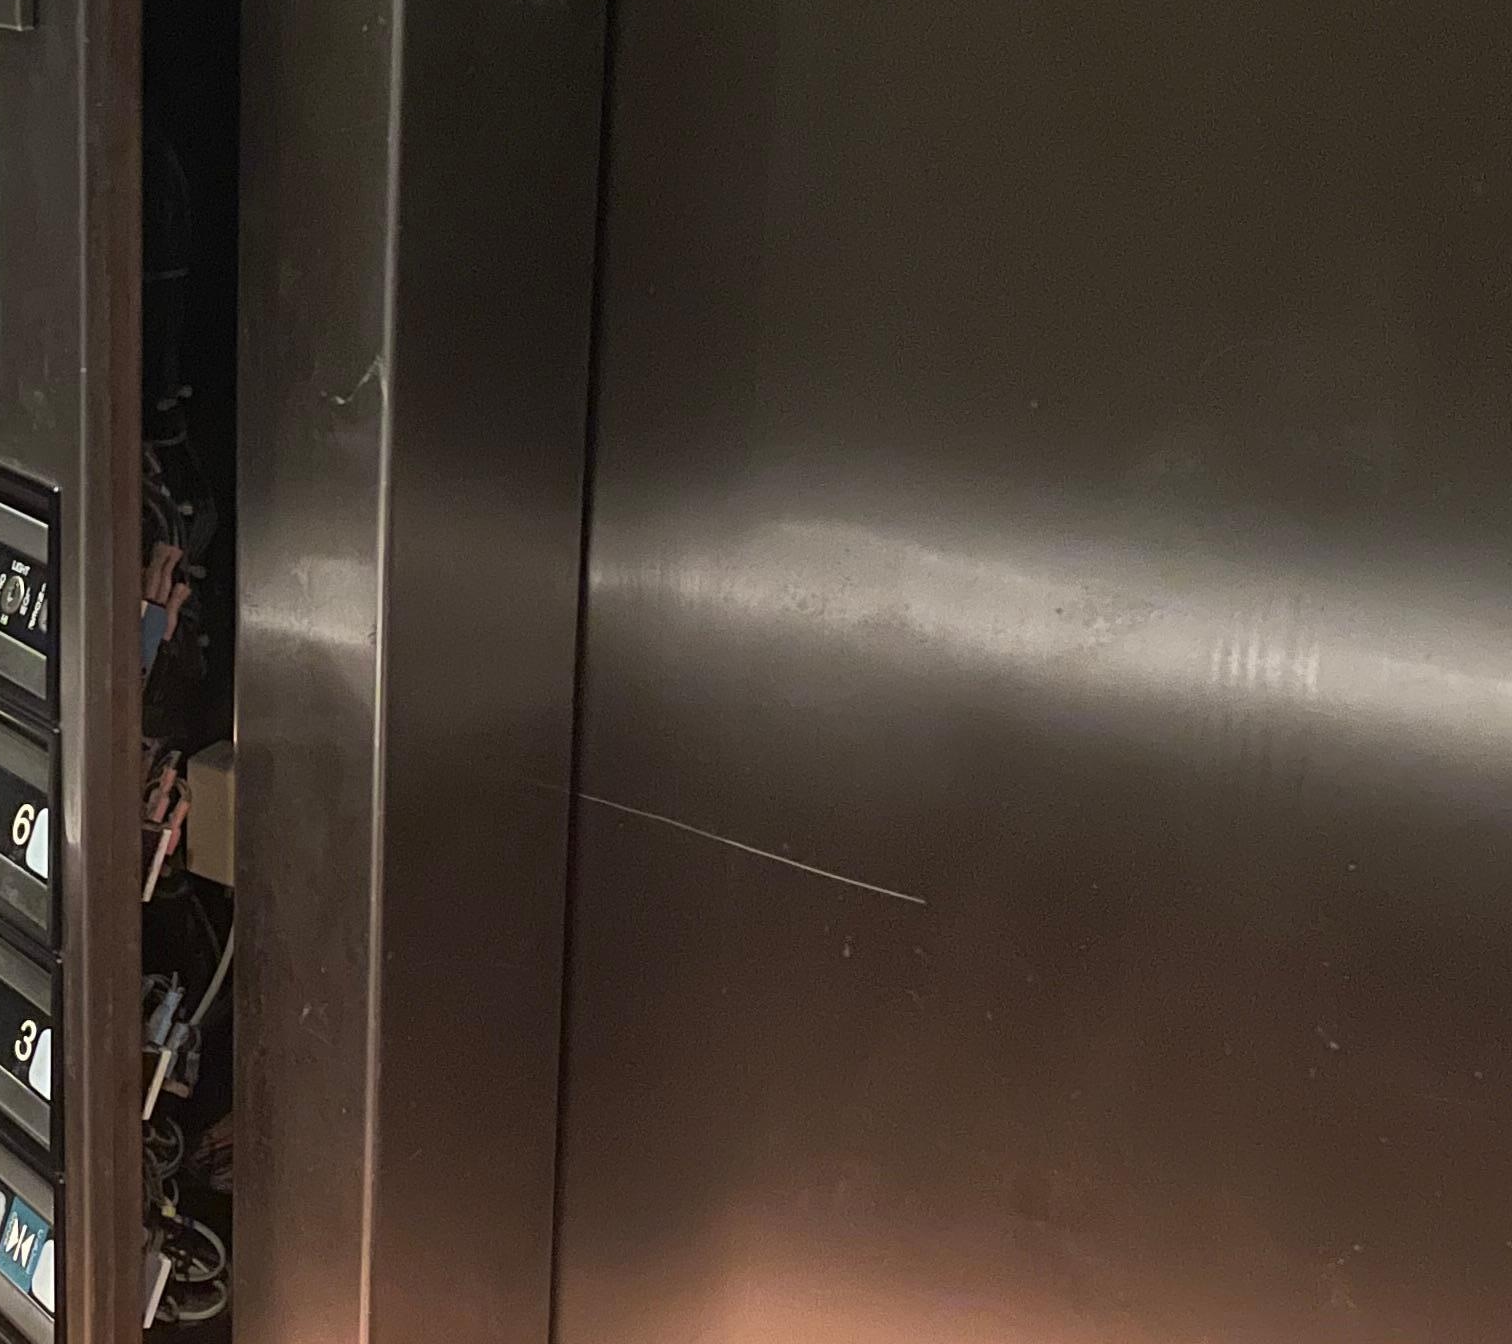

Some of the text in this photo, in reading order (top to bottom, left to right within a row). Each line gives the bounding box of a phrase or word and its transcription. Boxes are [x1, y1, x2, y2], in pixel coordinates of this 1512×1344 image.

[11, 560, 31, 576] LIGHT
[11, 803, 35, 846] 6
[14, 1019, 37, 1062] 3
